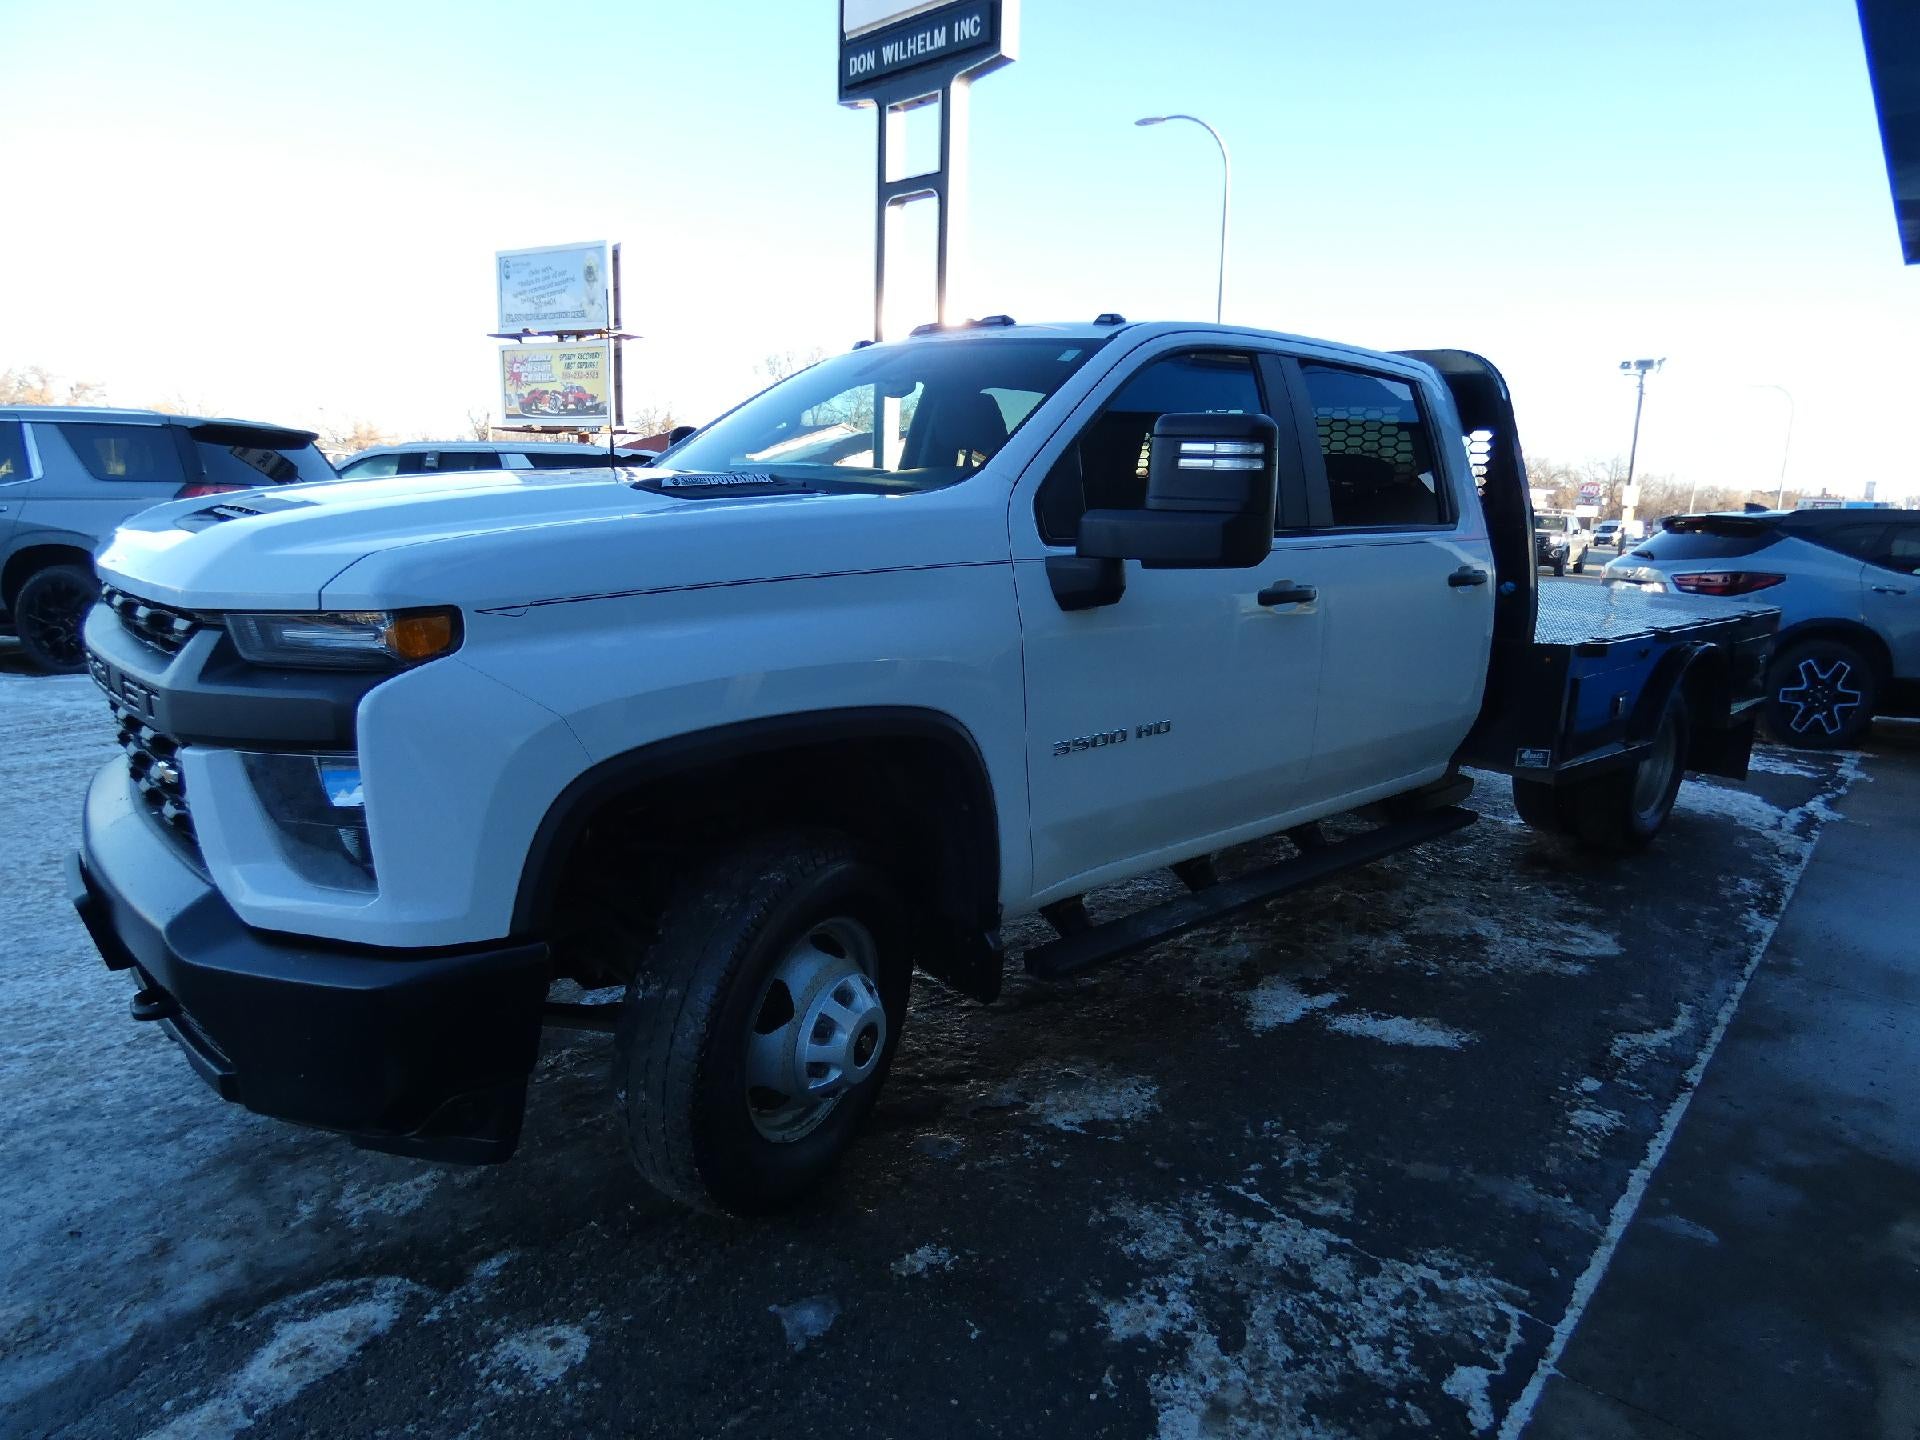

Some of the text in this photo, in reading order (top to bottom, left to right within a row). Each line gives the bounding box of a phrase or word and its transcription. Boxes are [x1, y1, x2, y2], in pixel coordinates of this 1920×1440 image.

[850, 15, 981, 76] DON WILHELM INC
[1053, 719, 1171, 756] 3500 HD
